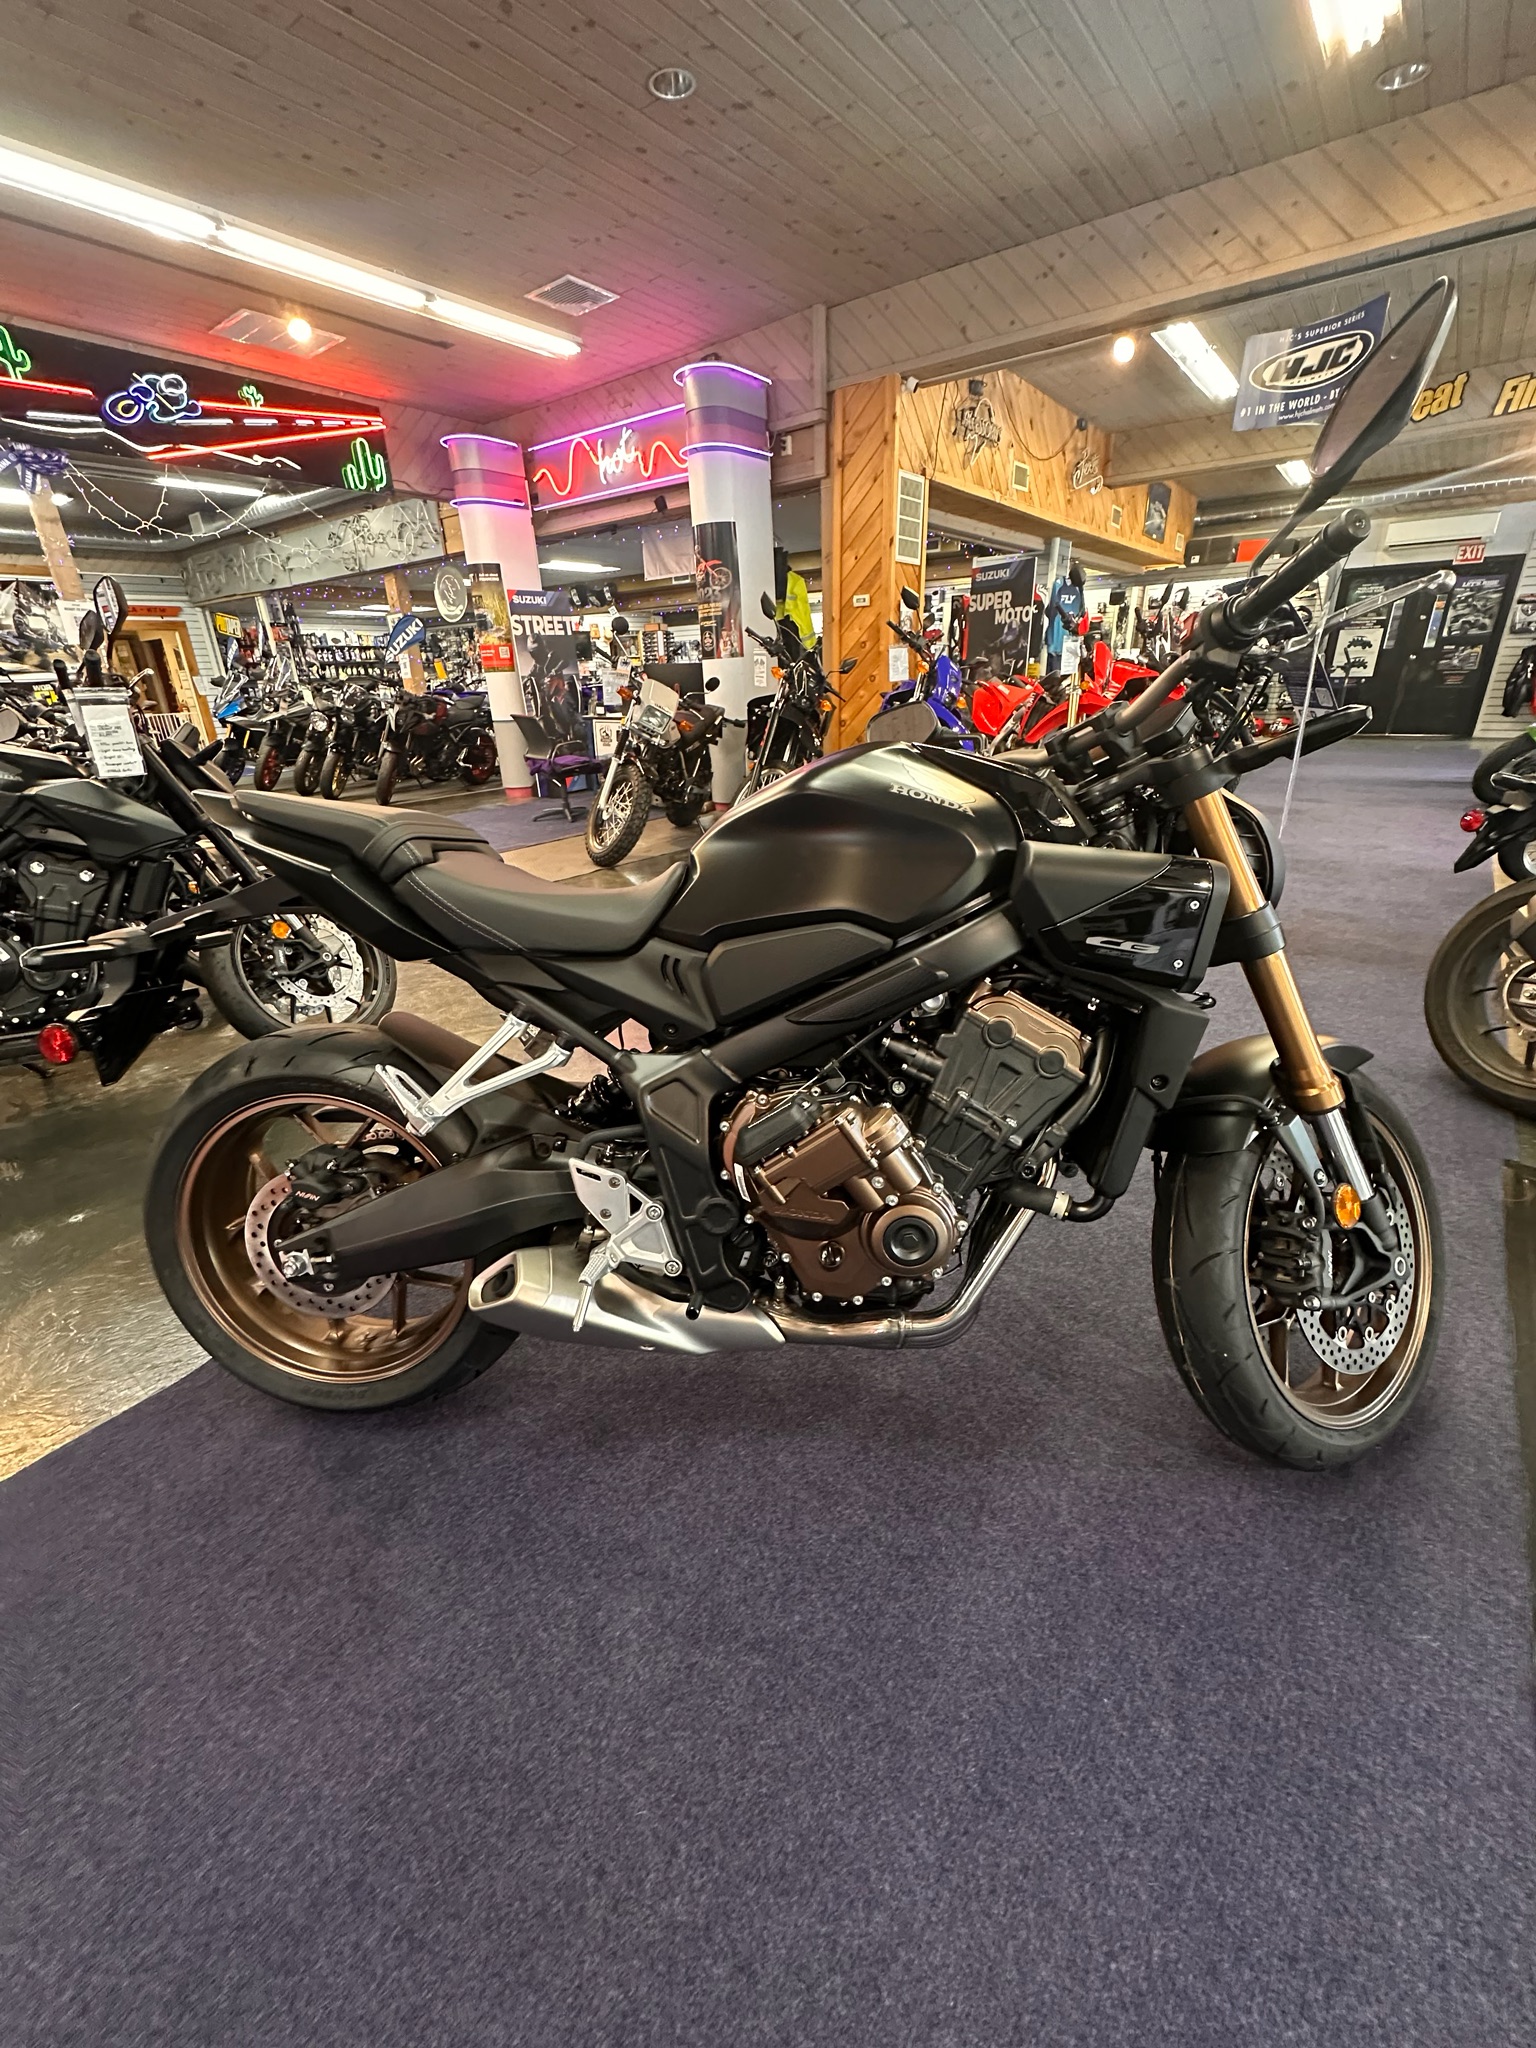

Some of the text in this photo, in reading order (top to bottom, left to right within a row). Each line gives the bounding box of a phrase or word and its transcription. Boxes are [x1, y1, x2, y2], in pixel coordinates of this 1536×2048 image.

[1305, 320, 1342, 338] SUPERIOR
[1344, 310, 1366, 326] SERIES
[1269, 336, 1361, 384] HJC
[1255, 405, 1265, 416] IN
[1269, 401, 1285, 414] THE
[1288, 393, 1321, 410] WORLD
[1329, 388, 1340, 401] BY
[1410, 371, 1470, 423] eat
[1457, 544, 1485, 560] EXIT
[975, 567, 1010, 582] SUZUKI
[512, 594, 547, 605] SUZUKI
[968, 590, 1013, 613] SUPER
[1060, 594, 1077, 604] FLY
[511, 614, 573, 636] STREET
[994, 604, 1032, 625] MOTO
[384, 617, 424, 664] SUZUKI
[889, 782, 976, 818] HONDA
